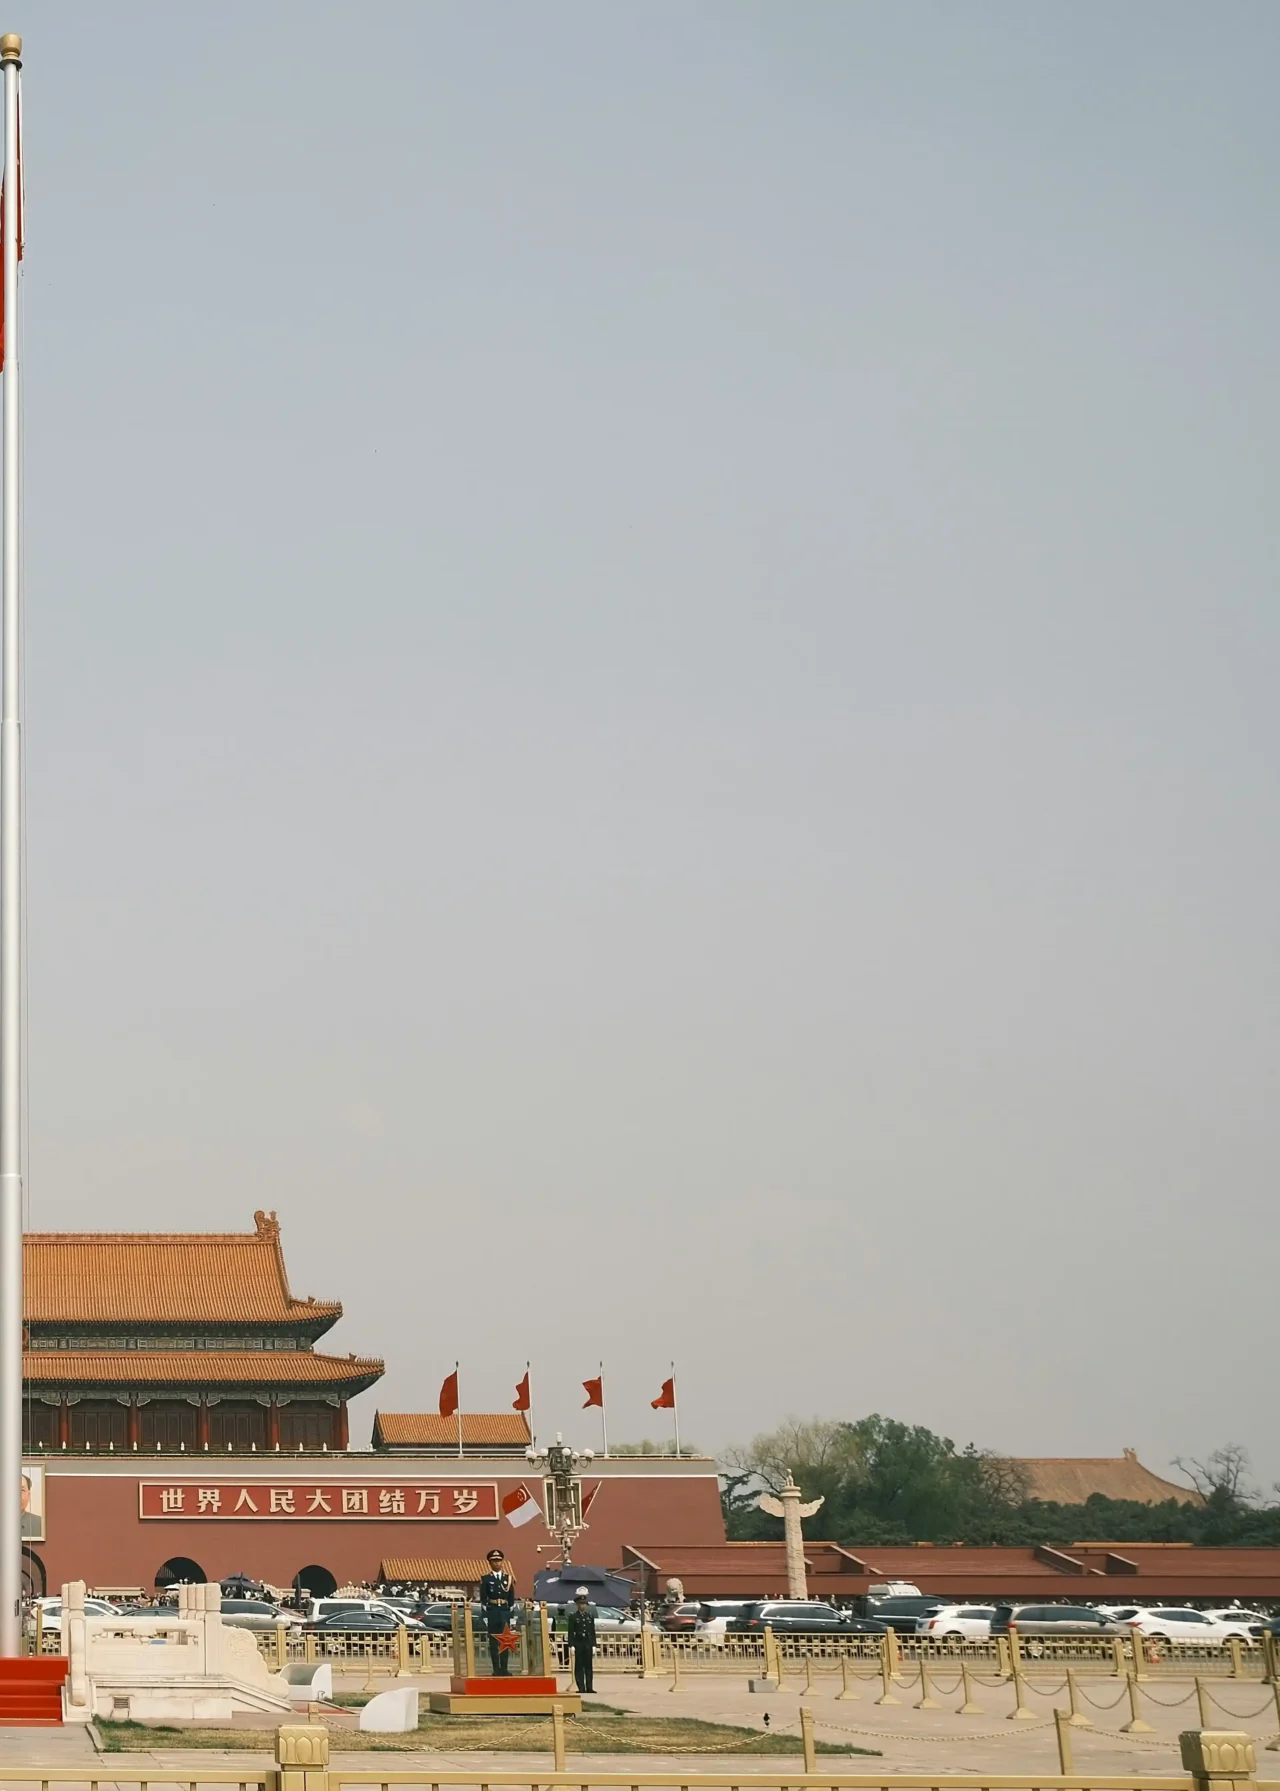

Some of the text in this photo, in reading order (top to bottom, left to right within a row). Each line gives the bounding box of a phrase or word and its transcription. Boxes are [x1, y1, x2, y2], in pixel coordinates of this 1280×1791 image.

[159, 1488, 479, 1514] 世界人民大团结万岁
